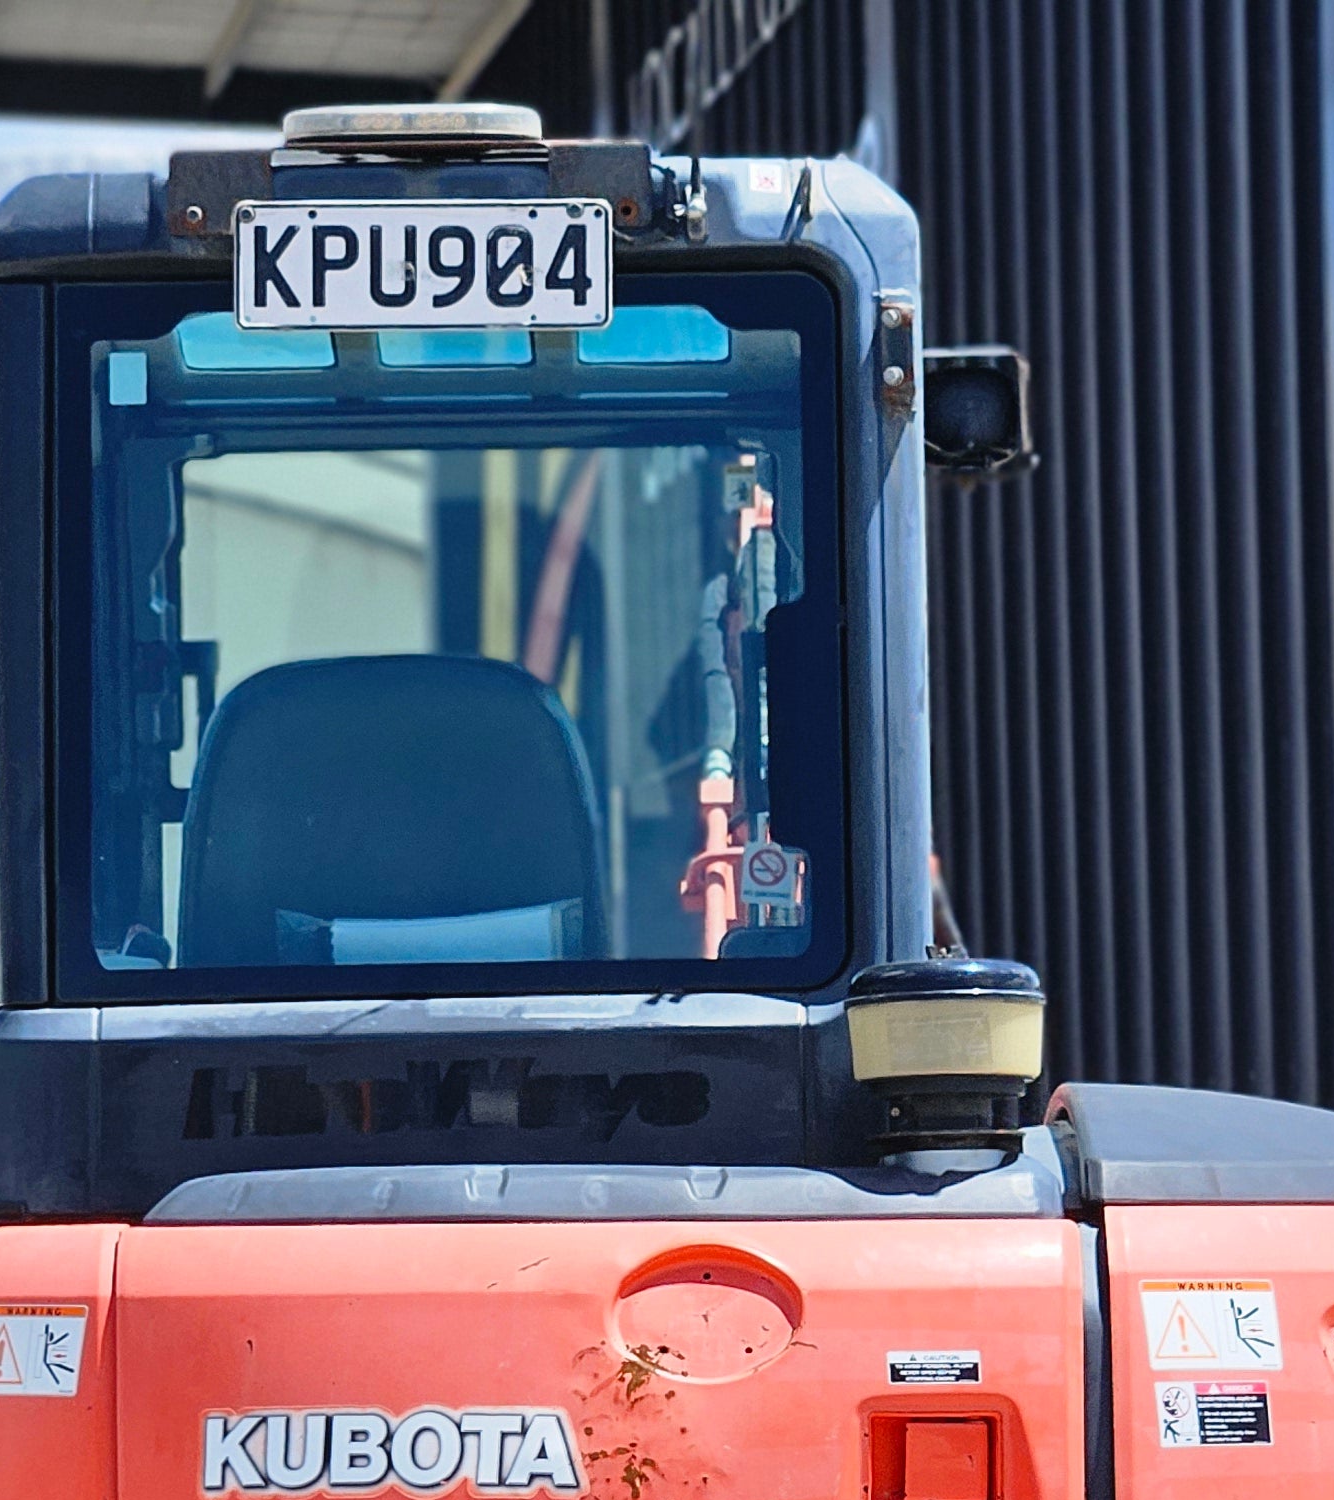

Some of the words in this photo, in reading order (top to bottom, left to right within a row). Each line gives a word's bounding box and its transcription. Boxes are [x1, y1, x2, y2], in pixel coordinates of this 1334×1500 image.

[254, 224, 592, 308] KPU904
[1178, 1282, 1243, 1290] WARNING
[7, 1307, 62, 1316] WARNING
[204, 1409, 579, 1490] KUBOTA
